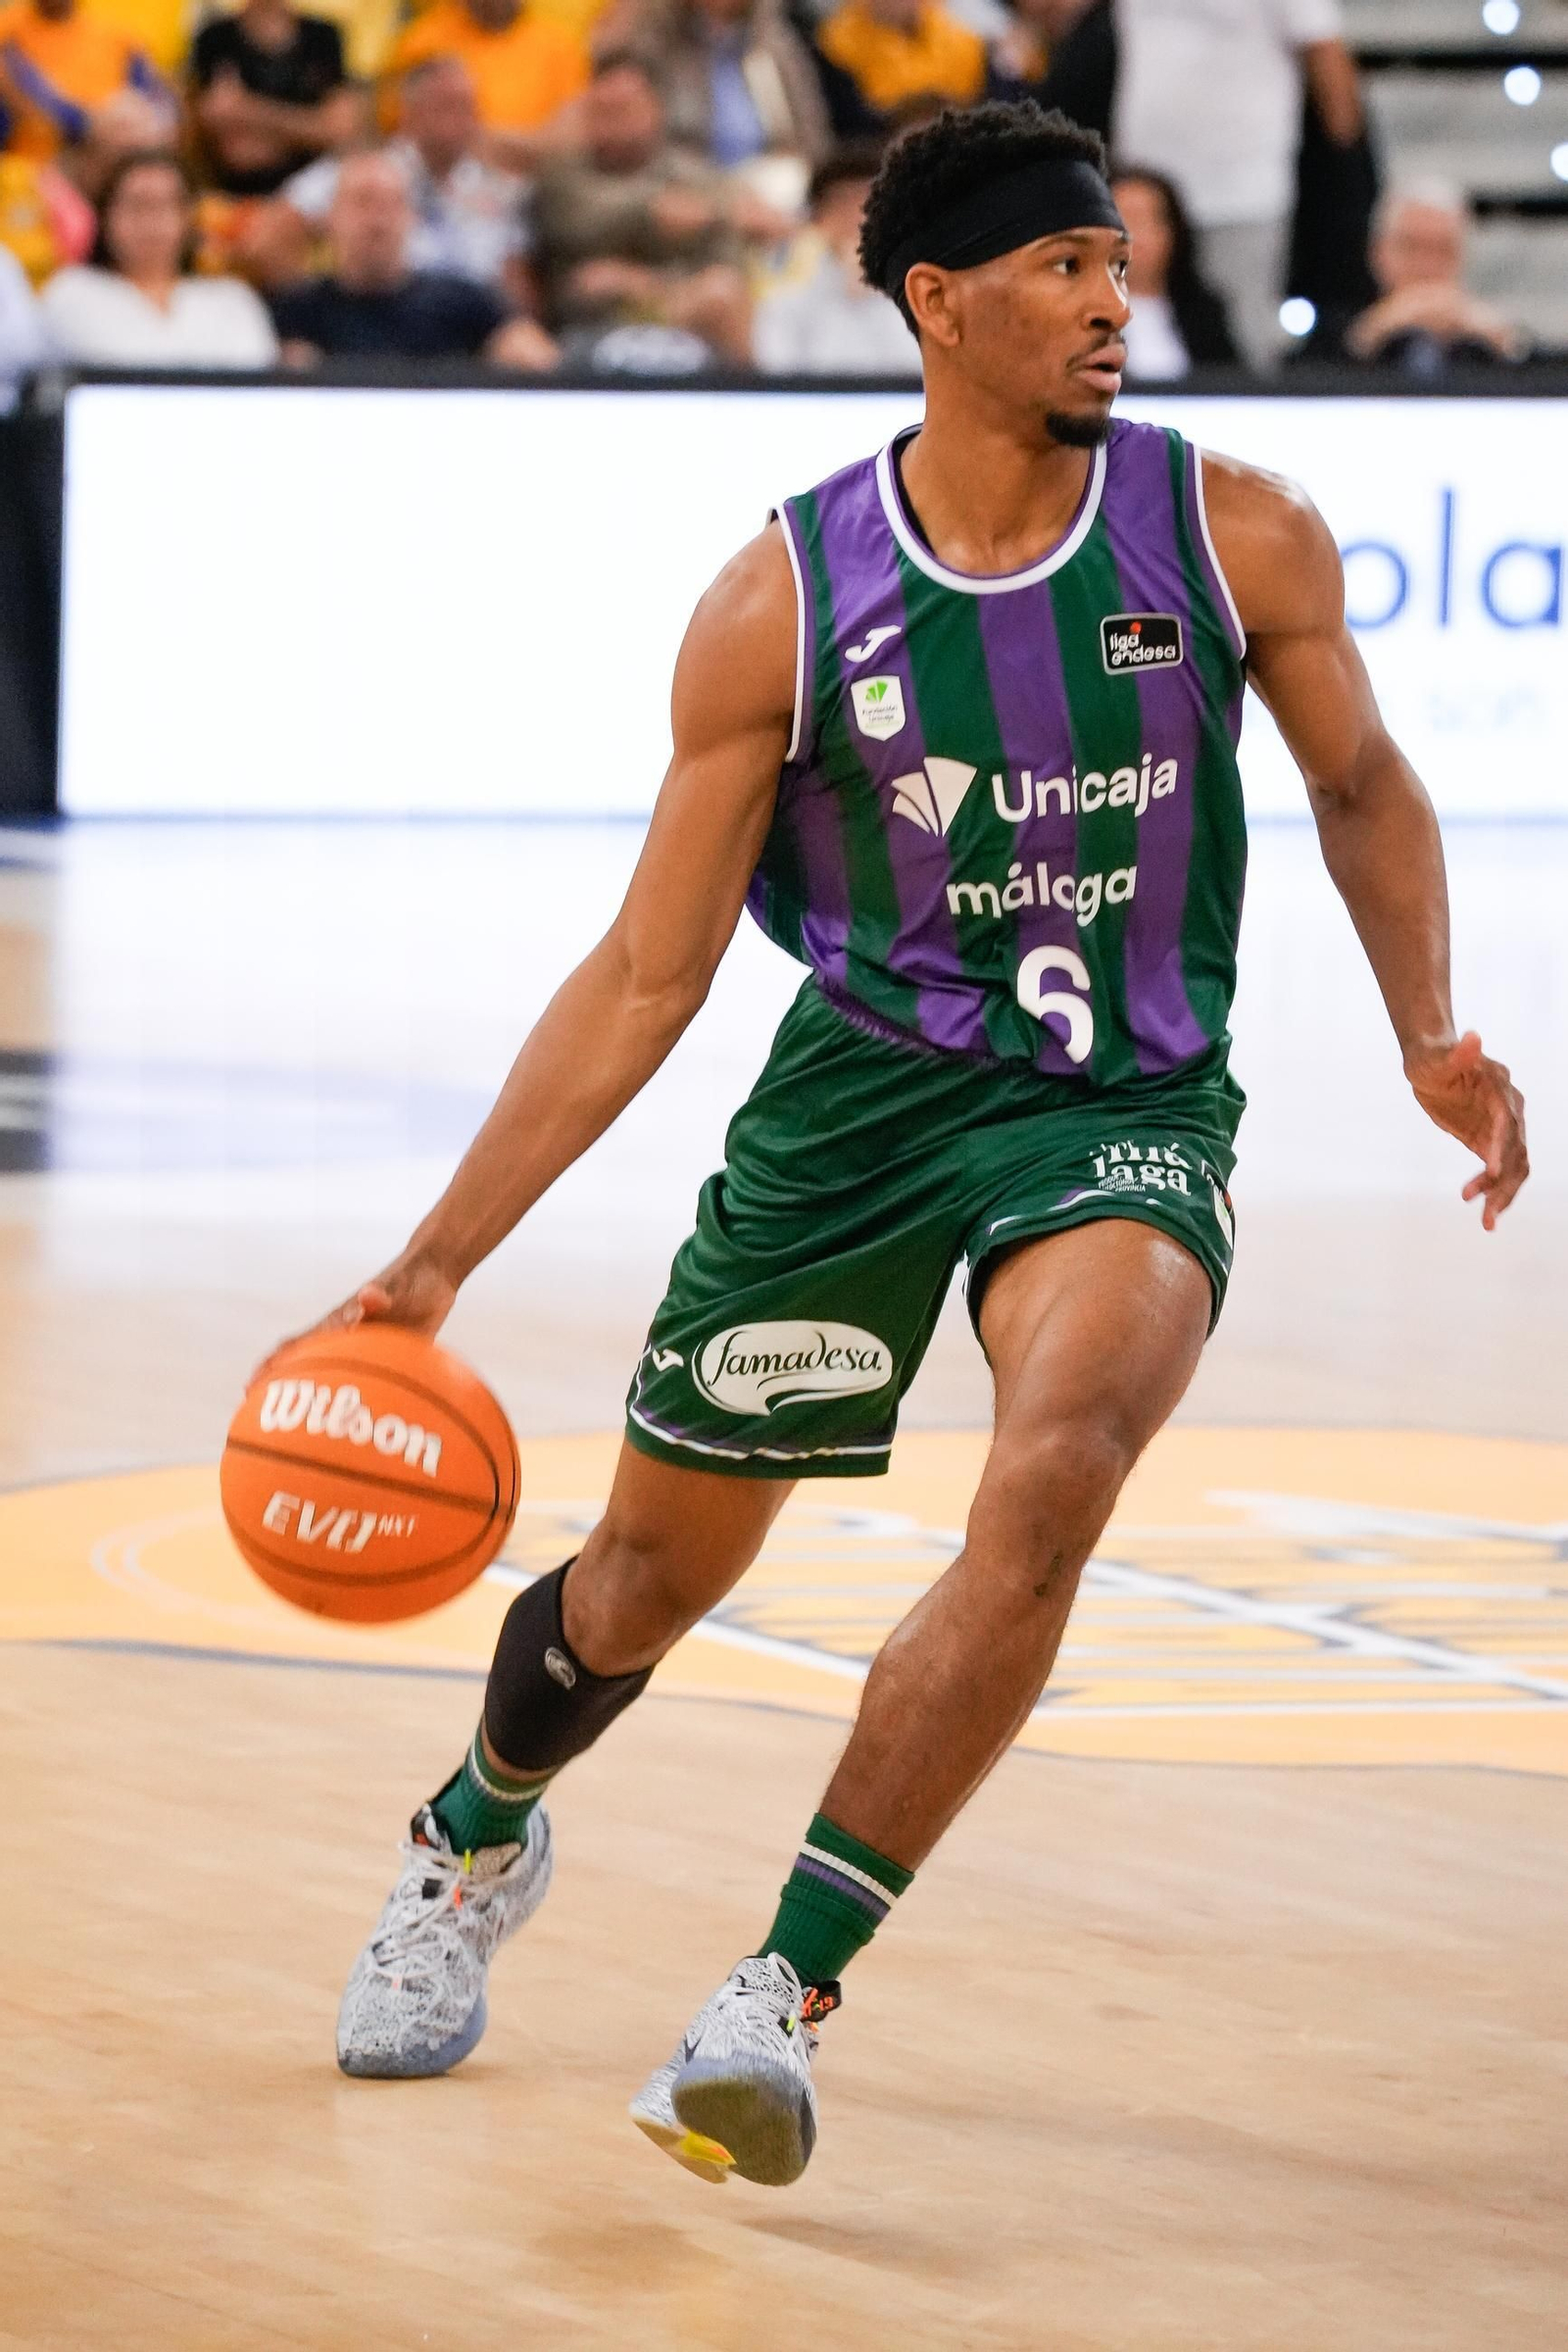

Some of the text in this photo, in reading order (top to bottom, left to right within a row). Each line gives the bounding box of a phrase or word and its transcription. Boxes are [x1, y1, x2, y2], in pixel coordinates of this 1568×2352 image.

[1109, 632, 1140, 654] liga
[1111, 644, 1177, 666] endesa
[992, 752, 1178, 823] Unicaja
[946, 861, 1137, 927] málaga
[1017, 946, 1094, 1064] 6
[260, 1378, 442, 1478] Wilson
[262, 1490, 378, 1553] EVO
